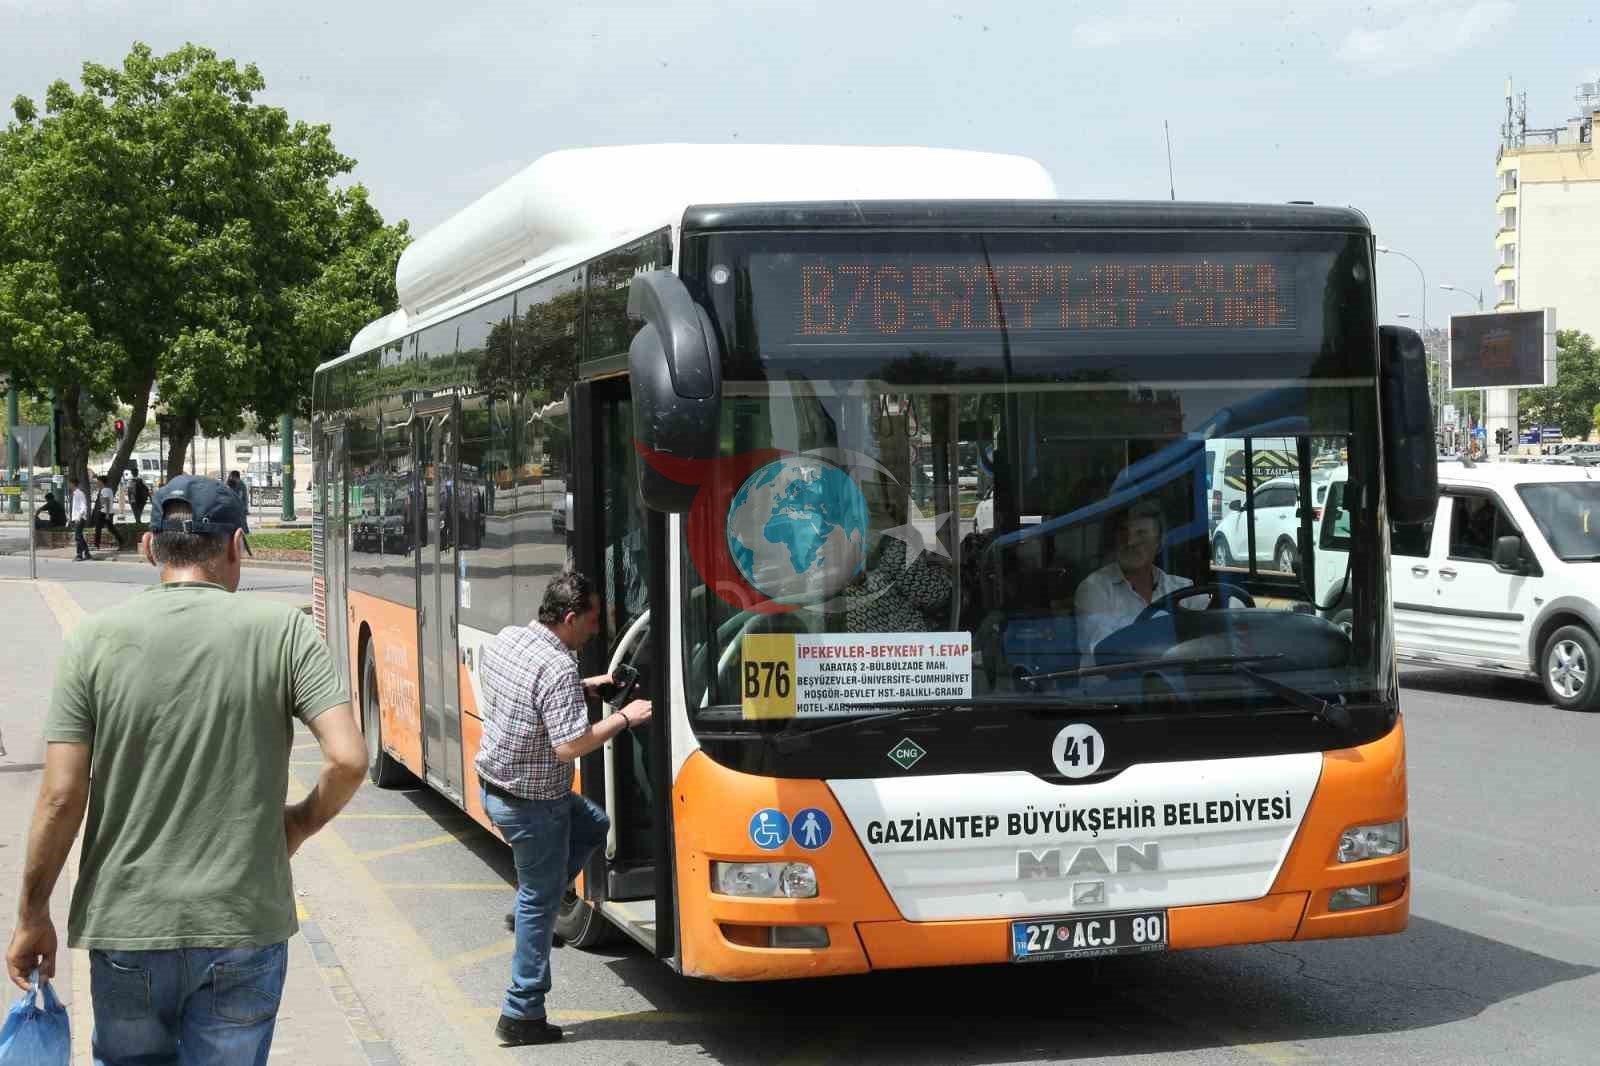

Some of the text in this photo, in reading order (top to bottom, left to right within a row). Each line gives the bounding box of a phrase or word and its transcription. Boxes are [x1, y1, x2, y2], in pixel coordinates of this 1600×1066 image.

[801, 263, 907, 335] B76
[819, 662, 858, 674] KARATAŞ
[925, 660, 949, 671] MAH.
[928, 643, 969, 657] 1.ETAP
[744, 661, 791, 699] B76
[896, 749, 918, 759] CNG
[1063, 735, 1095, 767] 41
[866, 790, 1291, 845] GAZİANTEP BÜYÜKŞEHİR BELEDİYESİ
[1016, 841, 1159, 880] MAN
[1027, 916, 1161, 952] 27 ACJ 80
